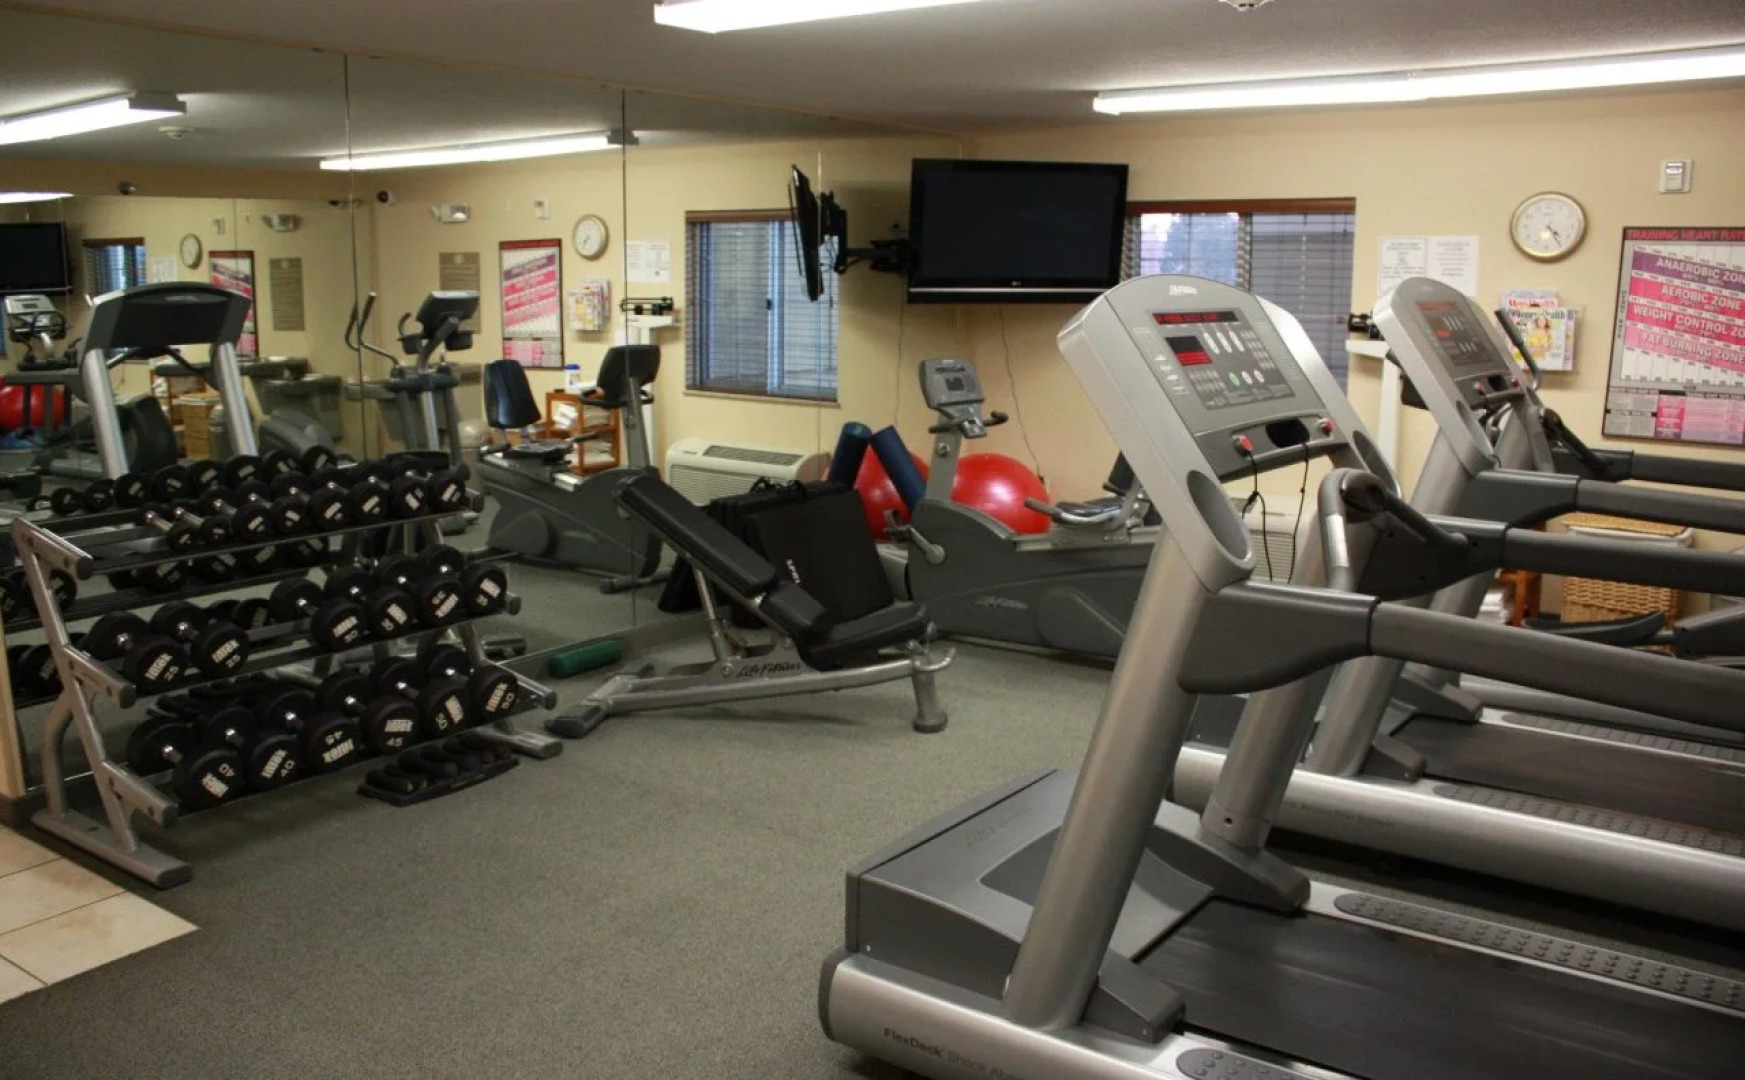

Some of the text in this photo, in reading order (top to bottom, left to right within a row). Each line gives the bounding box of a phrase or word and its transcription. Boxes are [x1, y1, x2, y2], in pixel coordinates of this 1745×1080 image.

[1656, 257, 1720, 279] ANAEROBIC
[1723, 271, 1745, 284] ZON
[1661, 284, 1709, 304] AEROBIC
[1712, 295, 1742, 310] ZONE
[1633, 304, 1674, 321] WEIGHT
[1676, 314, 1728, 335] CONTROL
[1643, 331, 1661, 343] FAT
[1663, 336, 1713, 356] BURNING
[218, 763, 235, 777] 40
[280, 760, 295, 778] 40
[884, 1027, 943, 1058] FlexDeck
